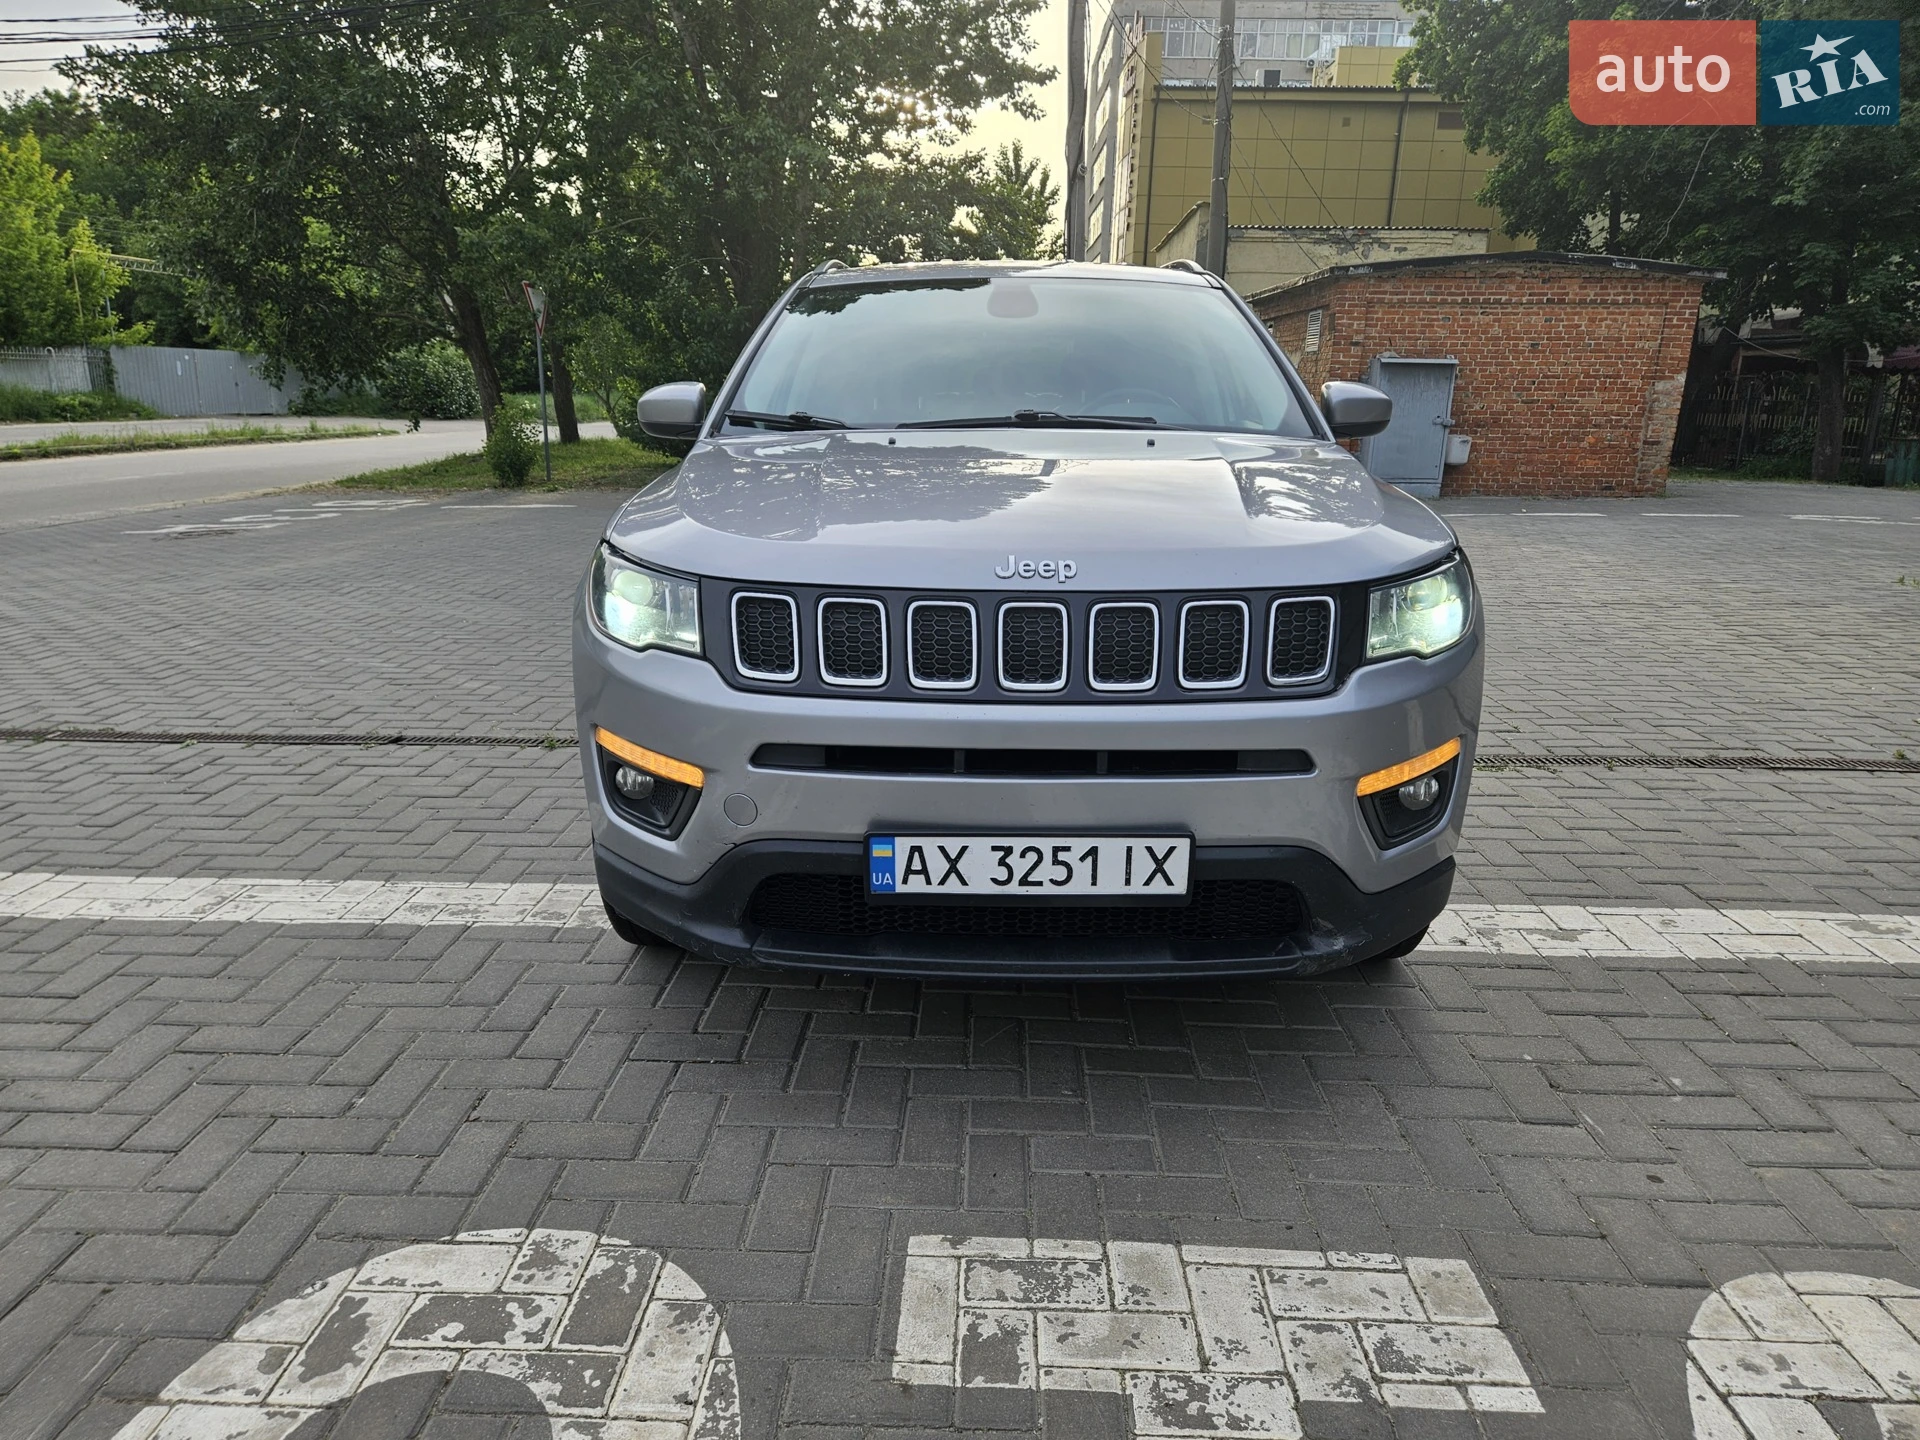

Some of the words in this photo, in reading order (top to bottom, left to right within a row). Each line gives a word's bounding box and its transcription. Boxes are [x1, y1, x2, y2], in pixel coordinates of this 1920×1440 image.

[994, 554, 1078, 583] Jeep
[872, 872, 893, 886] UA
[901, 845, 970, 887] AX
[989, 845, 1099, 887] 3251
[1124, 845, 1178, 887] IX
